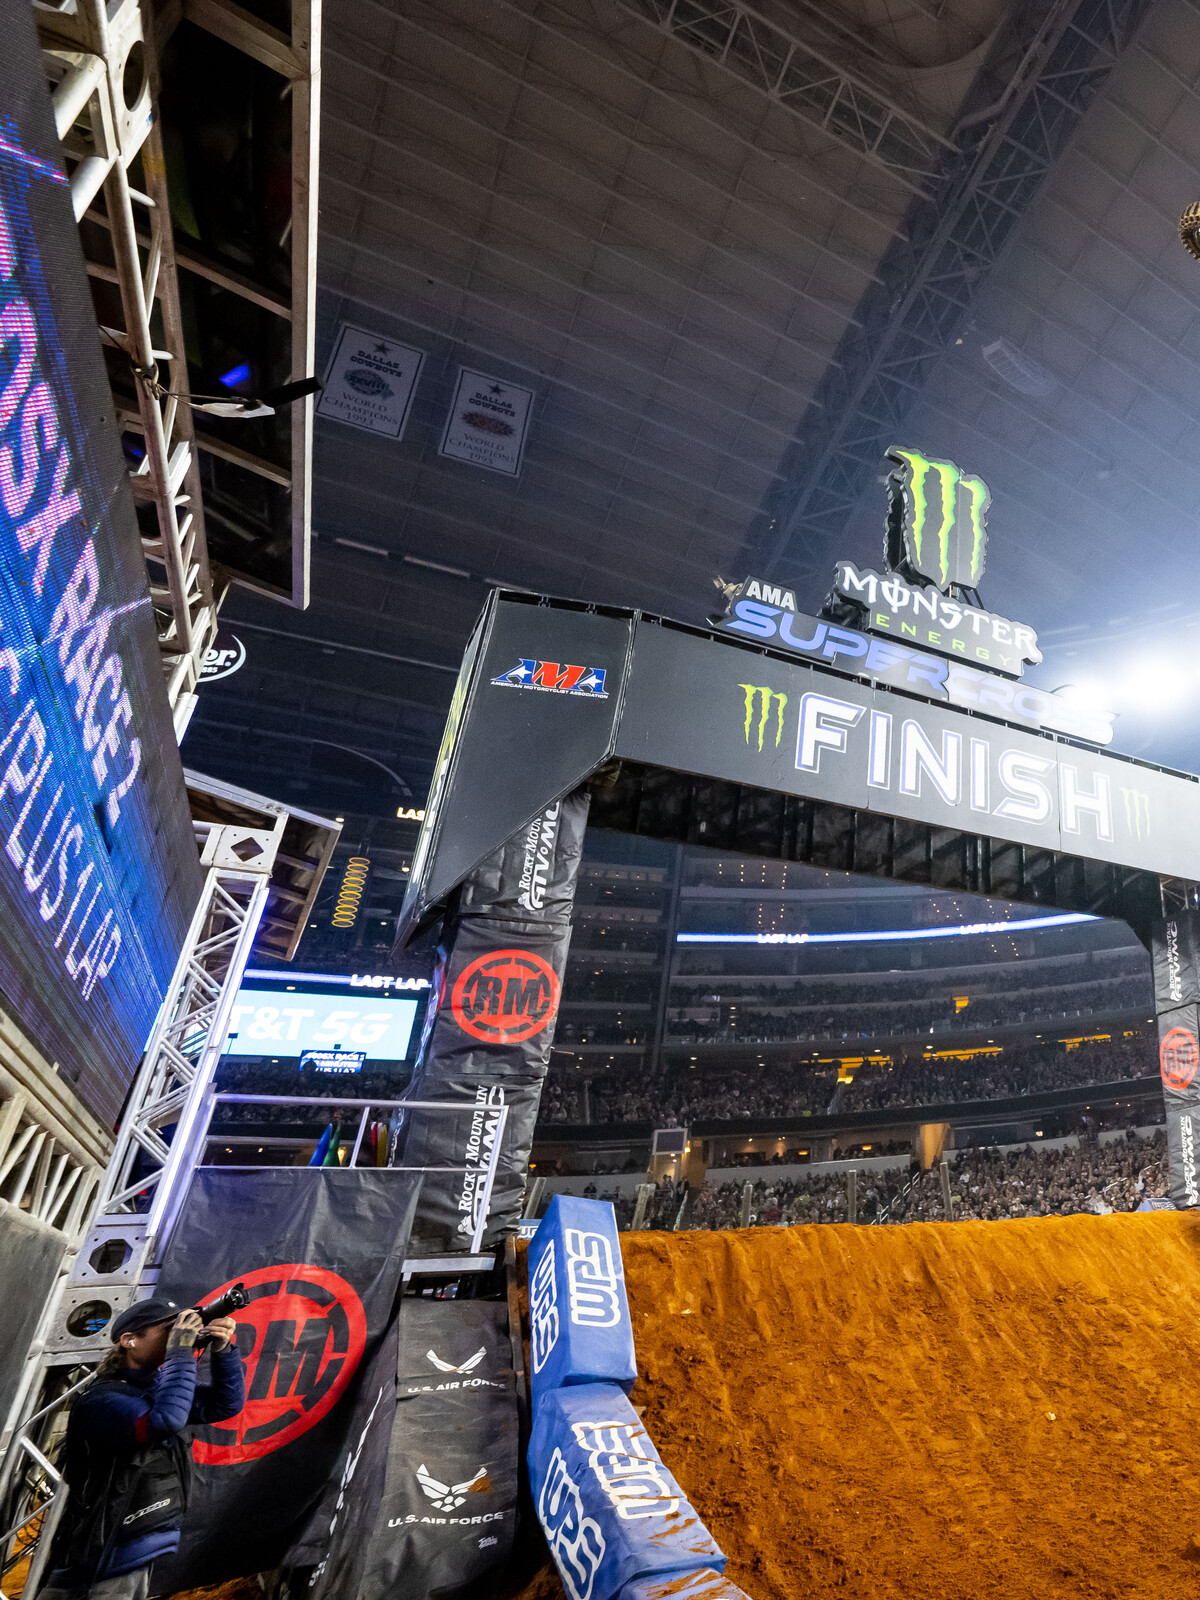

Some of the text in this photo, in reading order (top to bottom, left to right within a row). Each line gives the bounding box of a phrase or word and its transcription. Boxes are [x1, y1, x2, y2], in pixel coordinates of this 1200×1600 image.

[350, 356, 403, 378] COWBOYS
[358, 351, 399, 369] DALLAS
[325, 396, 398, 426] CHAMPIONS
[343, 392, 387, 412] WORLD
[469, 398, 516, 417] COWBOYS
[475, 392, 513, 409] DALLAS
[346, 413, 373, 427] 1993
[450, 438, 516, 463] CHAMPIONS
[464, 433, 504, 450] WORLD
[746, 580, 796, 611] AMA
[842, 566, 1040, 662] MONSTER
[875, 613, 1012, 666] ENERGY
[50, 538, 134, 790] RACE
[108, 738, 142, 829] 2
[490, 658, 609, 695] AMA
[490, 680, 608, 699] AMERICAN MOTORCYCLIST ASSOCIATION
[794, 691, 1115, 843] FINISH
[397, 807, 426, 822] LAS
[518, 854, 535, 890] ROCKY
[64, 882, 122, 1002] LAP
[757, 933, 809, 944] LAST LAP
[960, 921, 1008, 934] LAST LAP
[1166, 922, 1174, 963] MOUNTAIN
[350, 973, 429, 990] LAST LAP
[480, 977, 546, 1017] RM
[312, 1011, 393, 1044] 5G
[1162, 1043, 1197, 1073] RM
[1180, 1116, 1192, 1194] ROCKY MOUNTAIN
[565, 1227, 621, 1328] WPS
[530, 1239, 560, 1375] WPS
[436, 1381, 460, 1391] AIR
[571, 1420, 680, 1520] WPS
[388, 1511, 504, 1528] U.S. AIR FORCE
